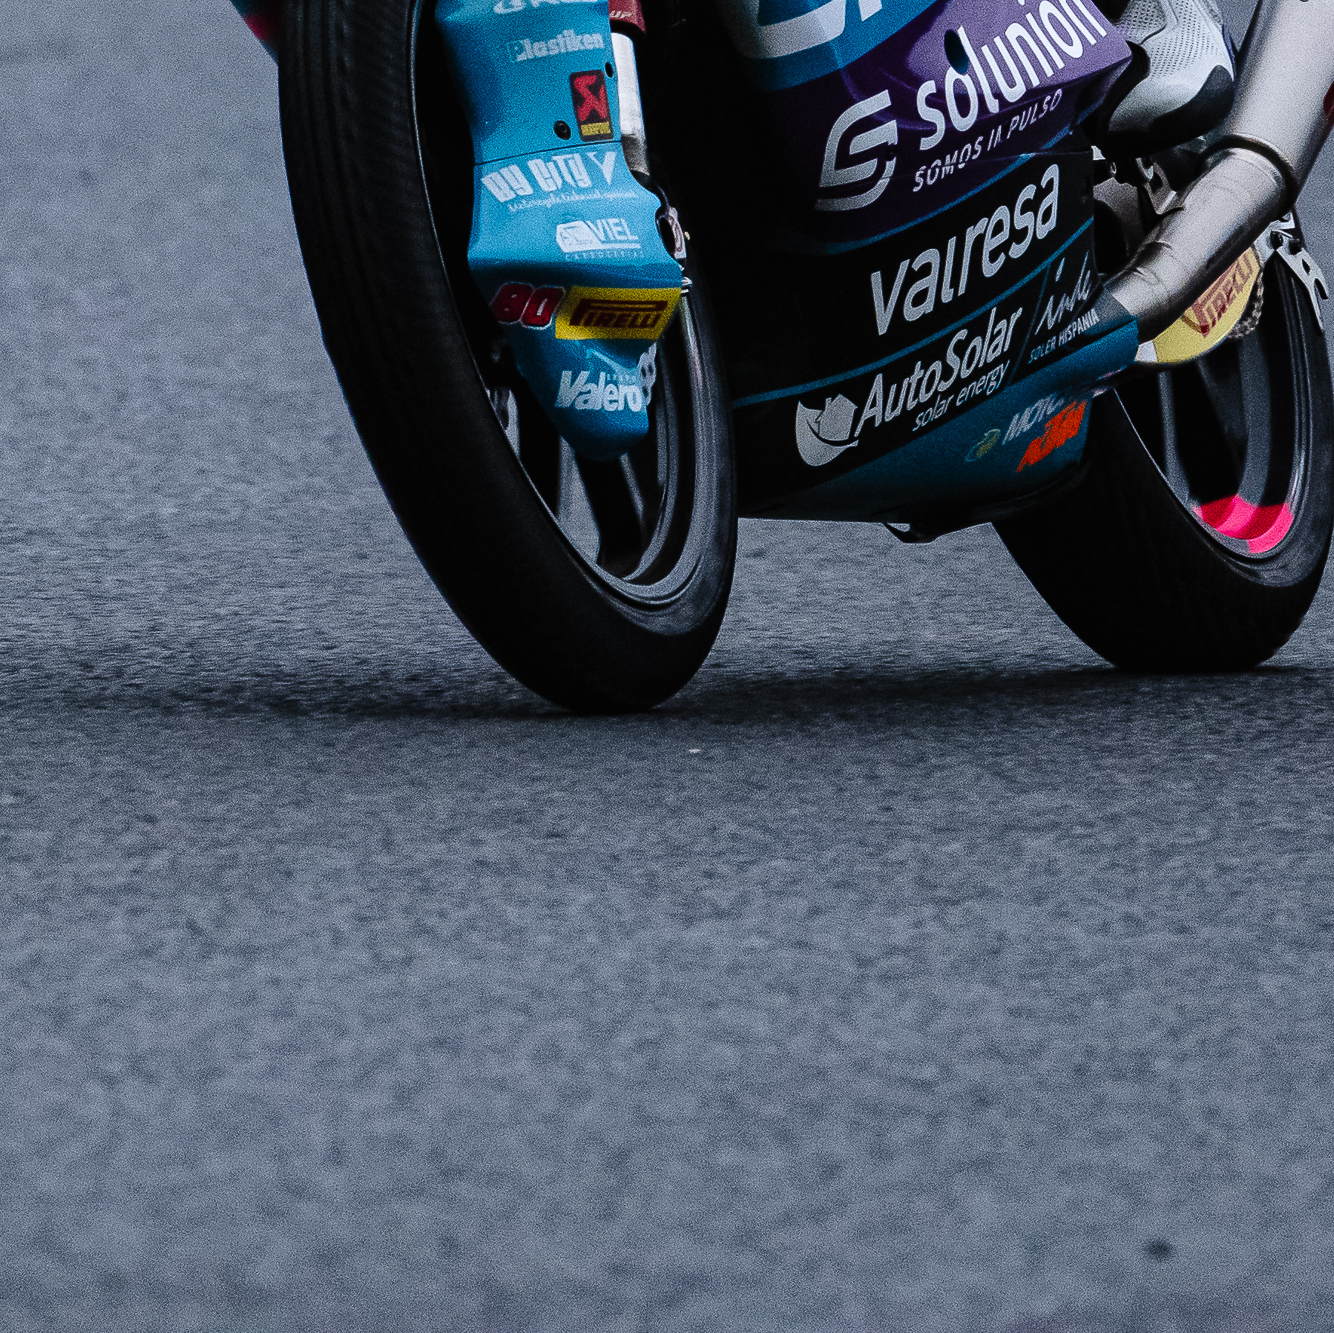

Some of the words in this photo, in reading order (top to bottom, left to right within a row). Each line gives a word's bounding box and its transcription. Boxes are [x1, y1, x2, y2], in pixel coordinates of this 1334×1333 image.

[912, 135, 984, 192] SOMOS
[586, 217, 639, 242] VIEL
[489, 281, 566, 330] 80
[568, 299, 670, 329] PIRELLI
[1058, 308, 1101, 348] HISPANIA
[554, 370, 644, 413] Valero
[854, 306, 1023, 438] AutoSolar
[912, 395, 954, 432] solar
[955, 359, 1011, 407] energy
